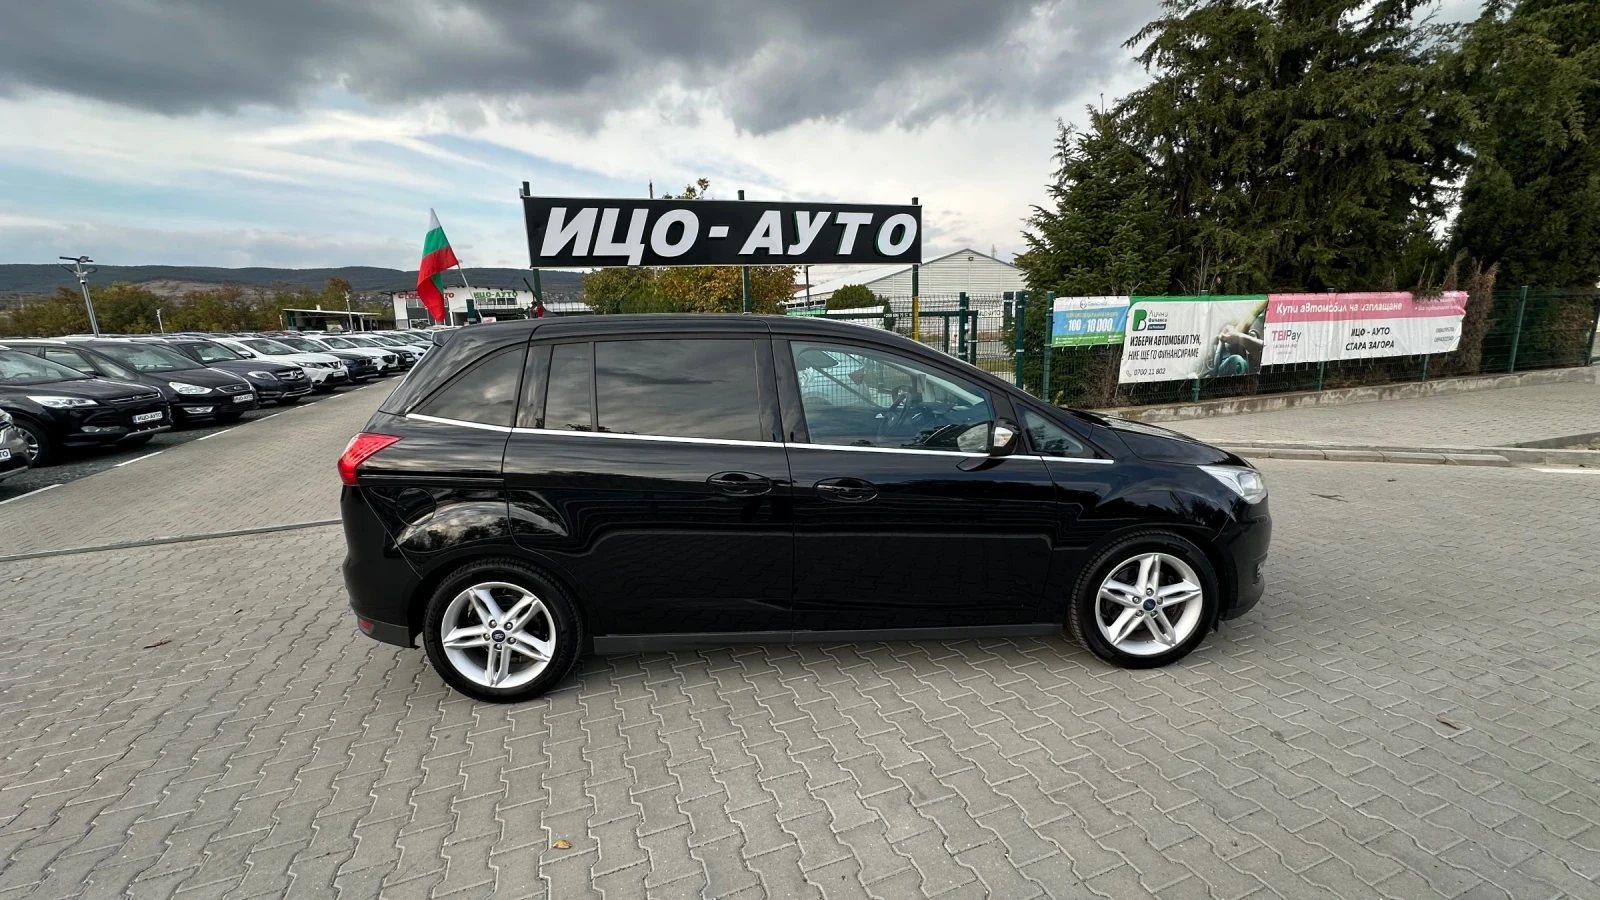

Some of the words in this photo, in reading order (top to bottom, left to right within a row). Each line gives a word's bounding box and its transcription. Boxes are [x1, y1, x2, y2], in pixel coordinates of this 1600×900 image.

[540, 207, 699, 266] ИЦО
[738, 209, 918, 257] АУТО
[1276, 303, 1298, 315] Купи
[1300, 302, 1346, 313] автомобил
[1068, 319, 1081, 331] 100
[1372, 327, 1390, 336] АУТО
[1130, 336, 1153, 346] ИЗБЕРИ
[1154, 335, 1188, 345] АВТОМОБИЛ
[1345, 342, 1366, 351] СТАРА
[1368, 341, 1394, 349] ЗАГОРА
[1128, 350, 1139, 360] НИЕ
[1141, 350, 1149, 360] ЩЕ
[1150, 350, 1157, 359] ГО
[1158, 348, 1199, 359] ФИНАНСИРАМЕ
